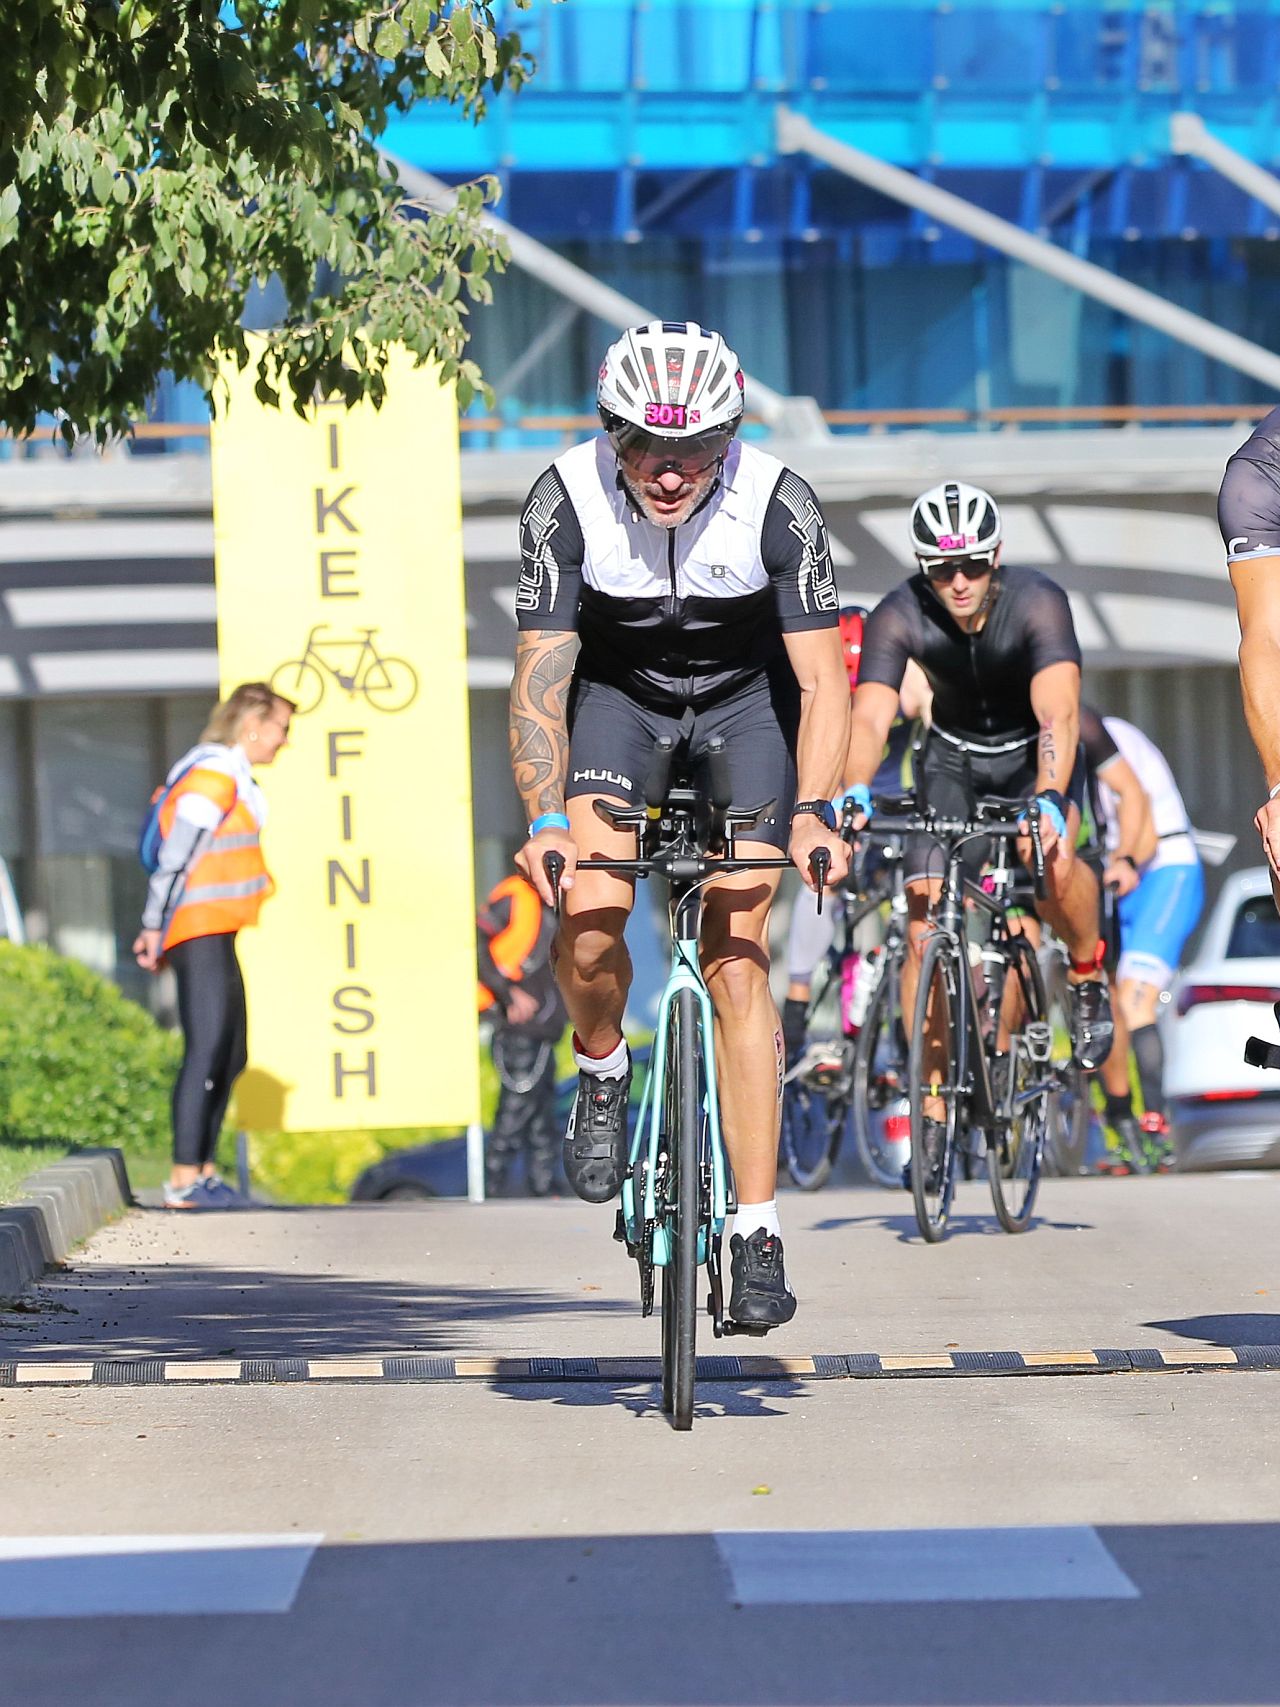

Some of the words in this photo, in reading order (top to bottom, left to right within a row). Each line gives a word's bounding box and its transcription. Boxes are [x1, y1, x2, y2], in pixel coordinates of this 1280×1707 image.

[646, 404, 684, 426] 301
[313, 368, 360, 598] IKE
[573, 768, 633, 791] HUUB
[327, 730, 377, 1099] FINISH
